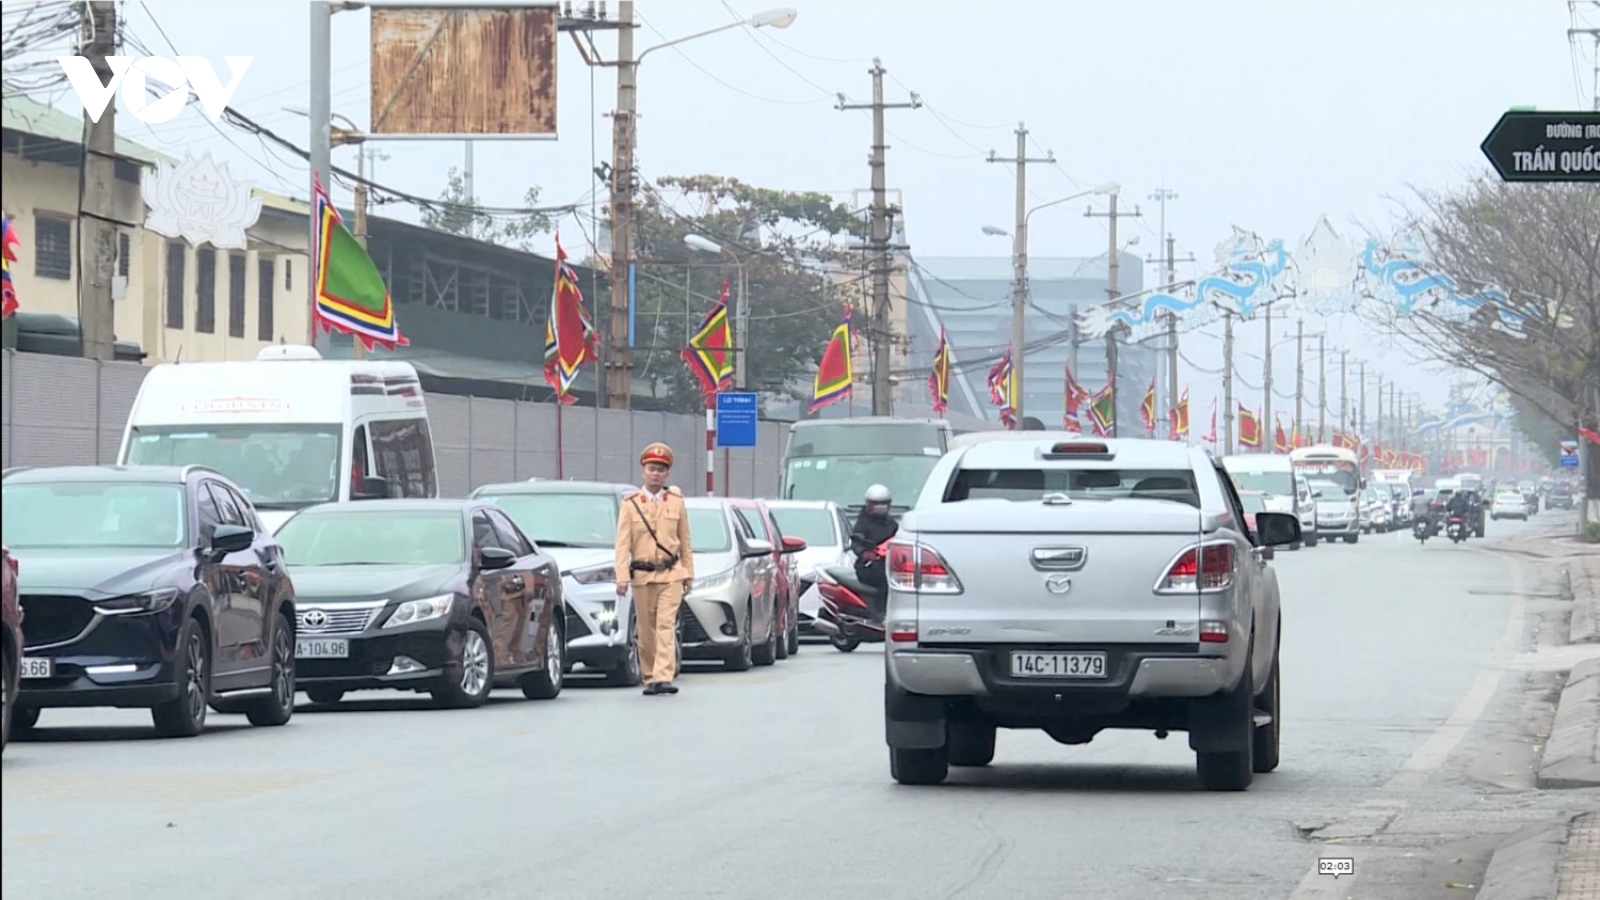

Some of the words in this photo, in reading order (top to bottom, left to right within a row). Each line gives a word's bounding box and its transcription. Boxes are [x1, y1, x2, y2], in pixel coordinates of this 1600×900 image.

[1546, 121, 1582, 138] ĐƯỜNG
[1512, 144, 1555, 171] TRẦN
[1561, 145, 1600, 173] QUỐC
[1017, 655, 1103, 674] 14C-113.79
